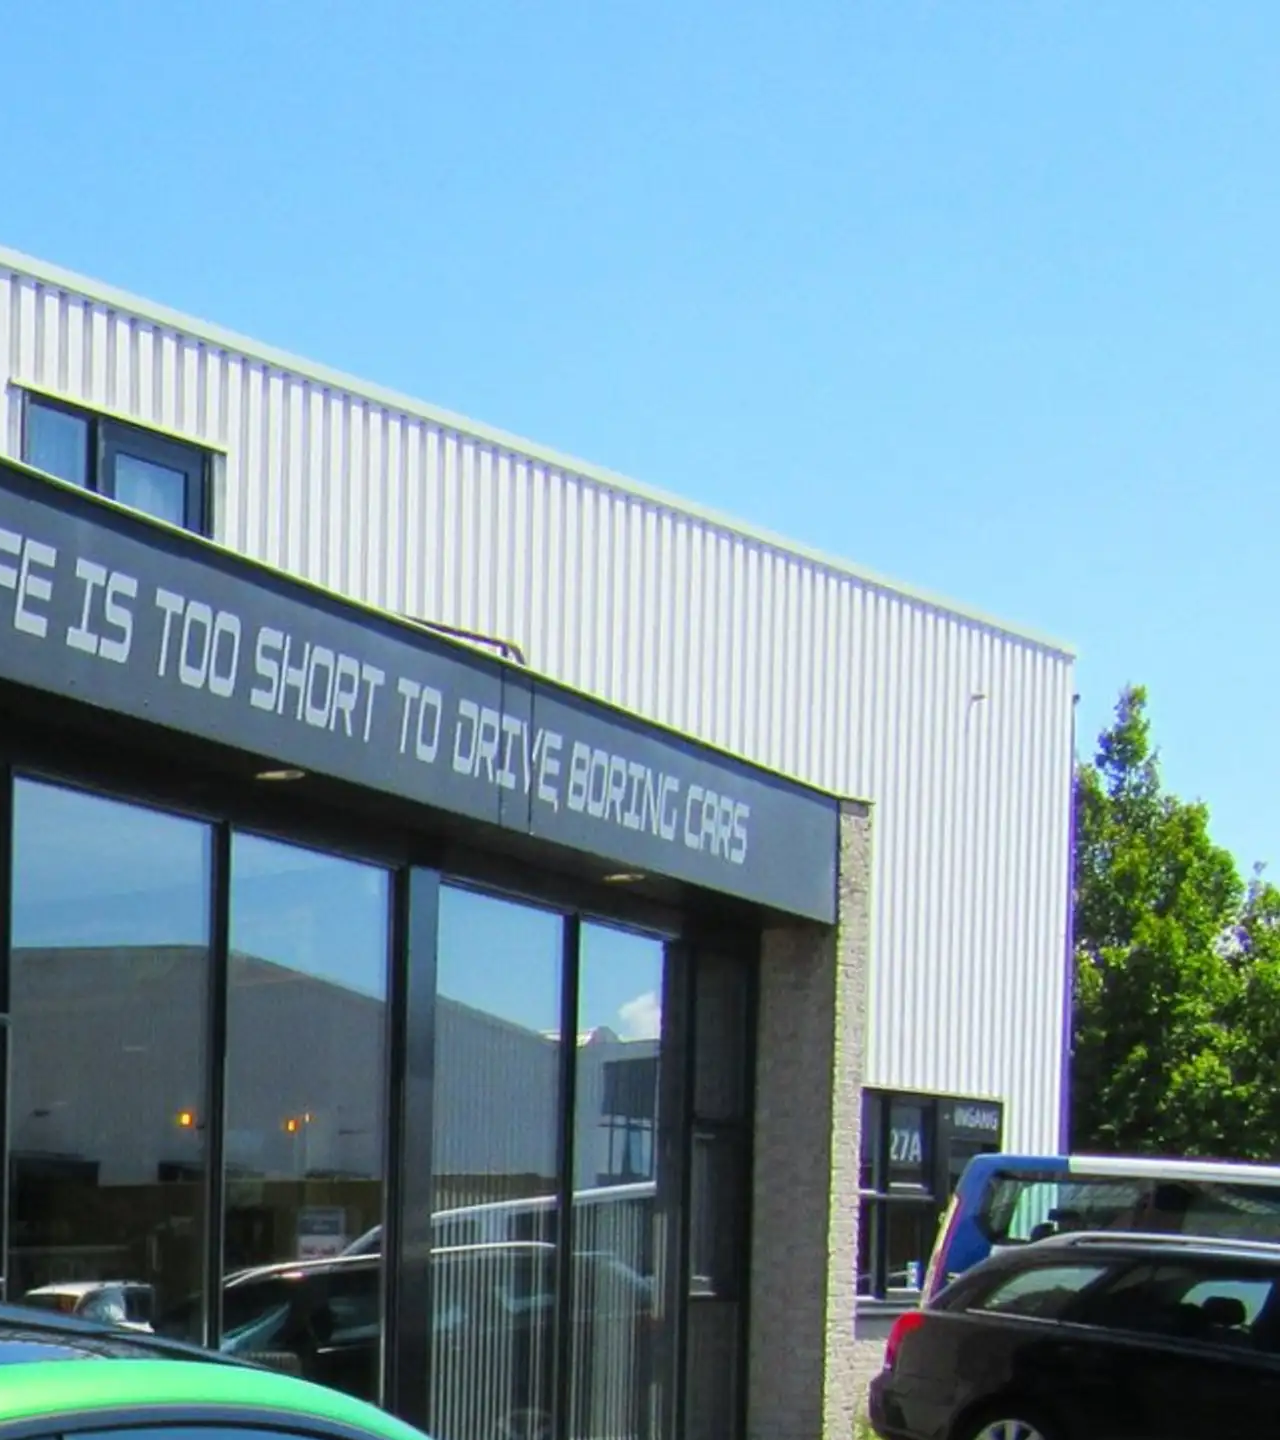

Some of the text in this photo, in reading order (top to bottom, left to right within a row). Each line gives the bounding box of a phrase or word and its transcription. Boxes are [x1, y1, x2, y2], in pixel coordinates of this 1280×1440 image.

[66, 558, 138, 663] IS
[155, 587, 241, 697] TOO
[250, 626, 385, 742] SHORT
[397, 678, 442, 764] TO
[452, 700, 562, 810] DRIVE
[567, 741, 679, 841] BORING
[684, 784, 750, 864] CARS
[891, 1128, 922, 1162] 27A
